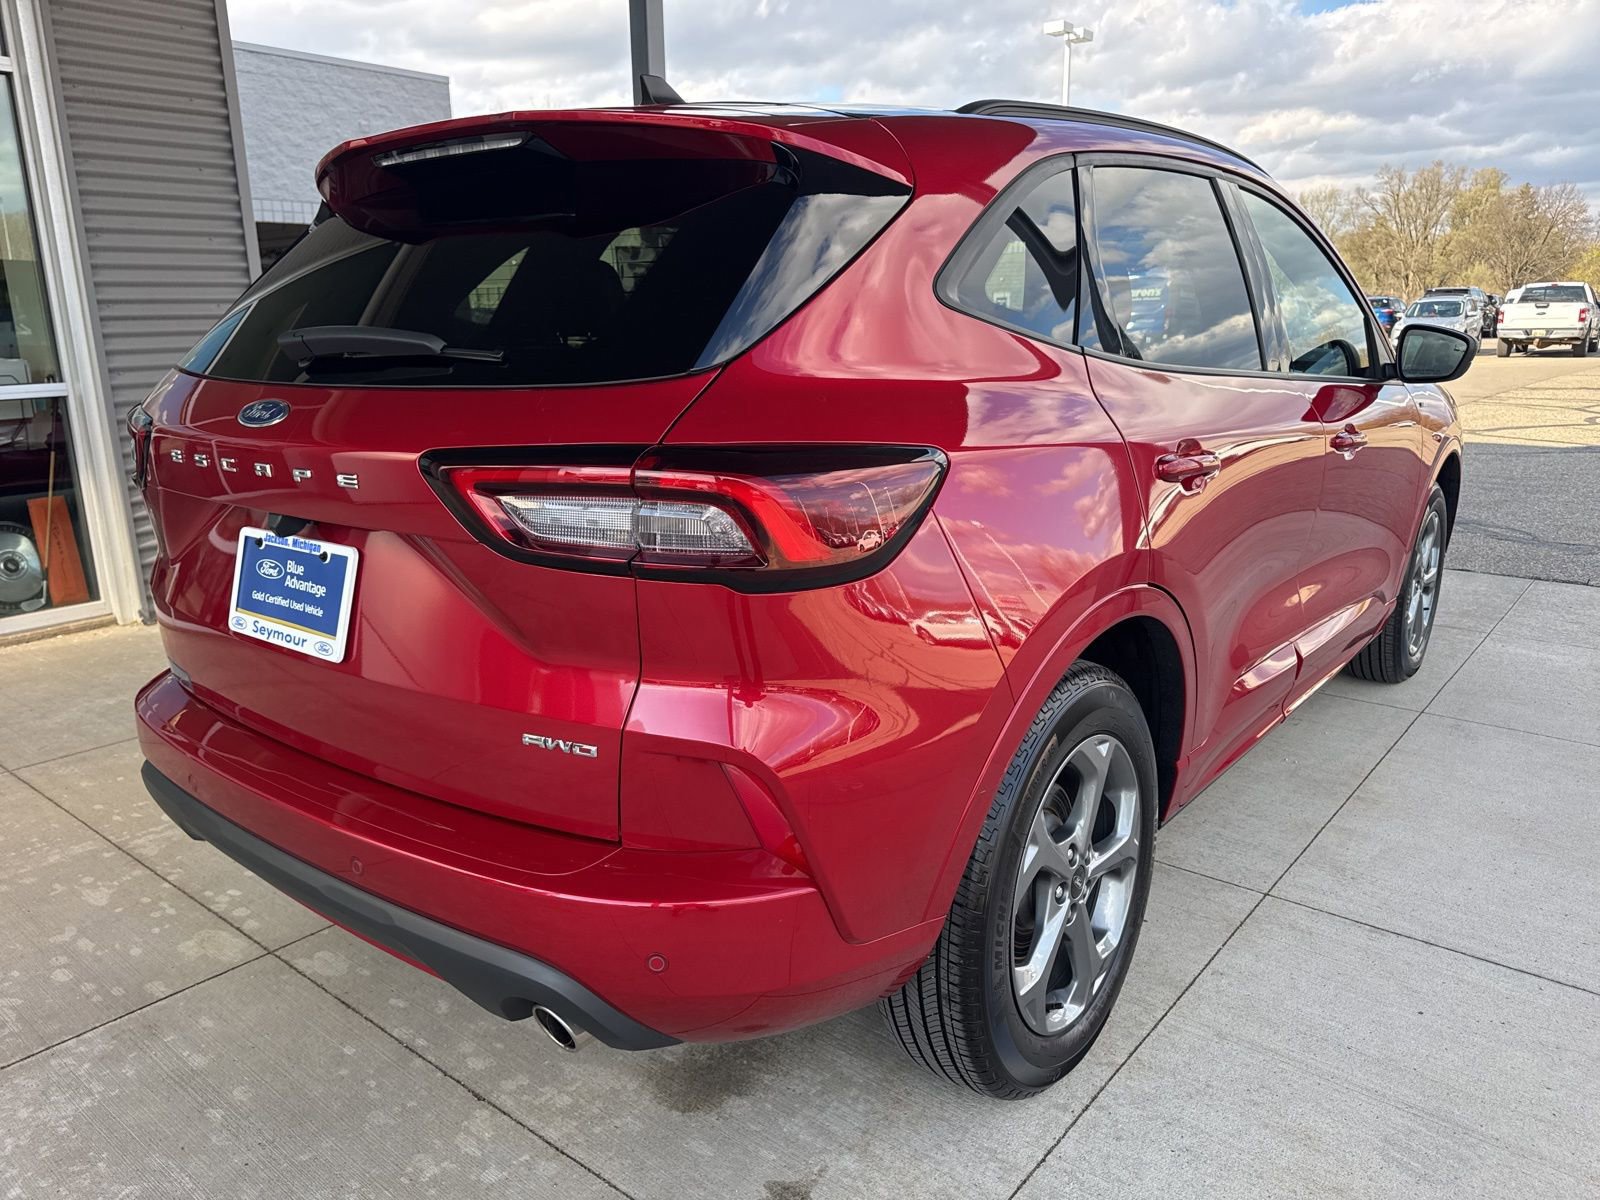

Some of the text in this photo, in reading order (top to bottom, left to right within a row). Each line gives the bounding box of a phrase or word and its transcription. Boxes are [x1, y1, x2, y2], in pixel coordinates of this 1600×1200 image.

[170, 449, 359, 490] ESCAPE
[292, 538, 321, 554] Michigan
[261, 561, 279, 577] Ford
[286, 560, 305, 576] Blue
[284, 575, 327, 597] Advantage
[252, 590, 324, 617] Gold Certified Used Vehicle
[252, 620, 308, 647] Seymour
[522, 733, 598, 758] AWD
